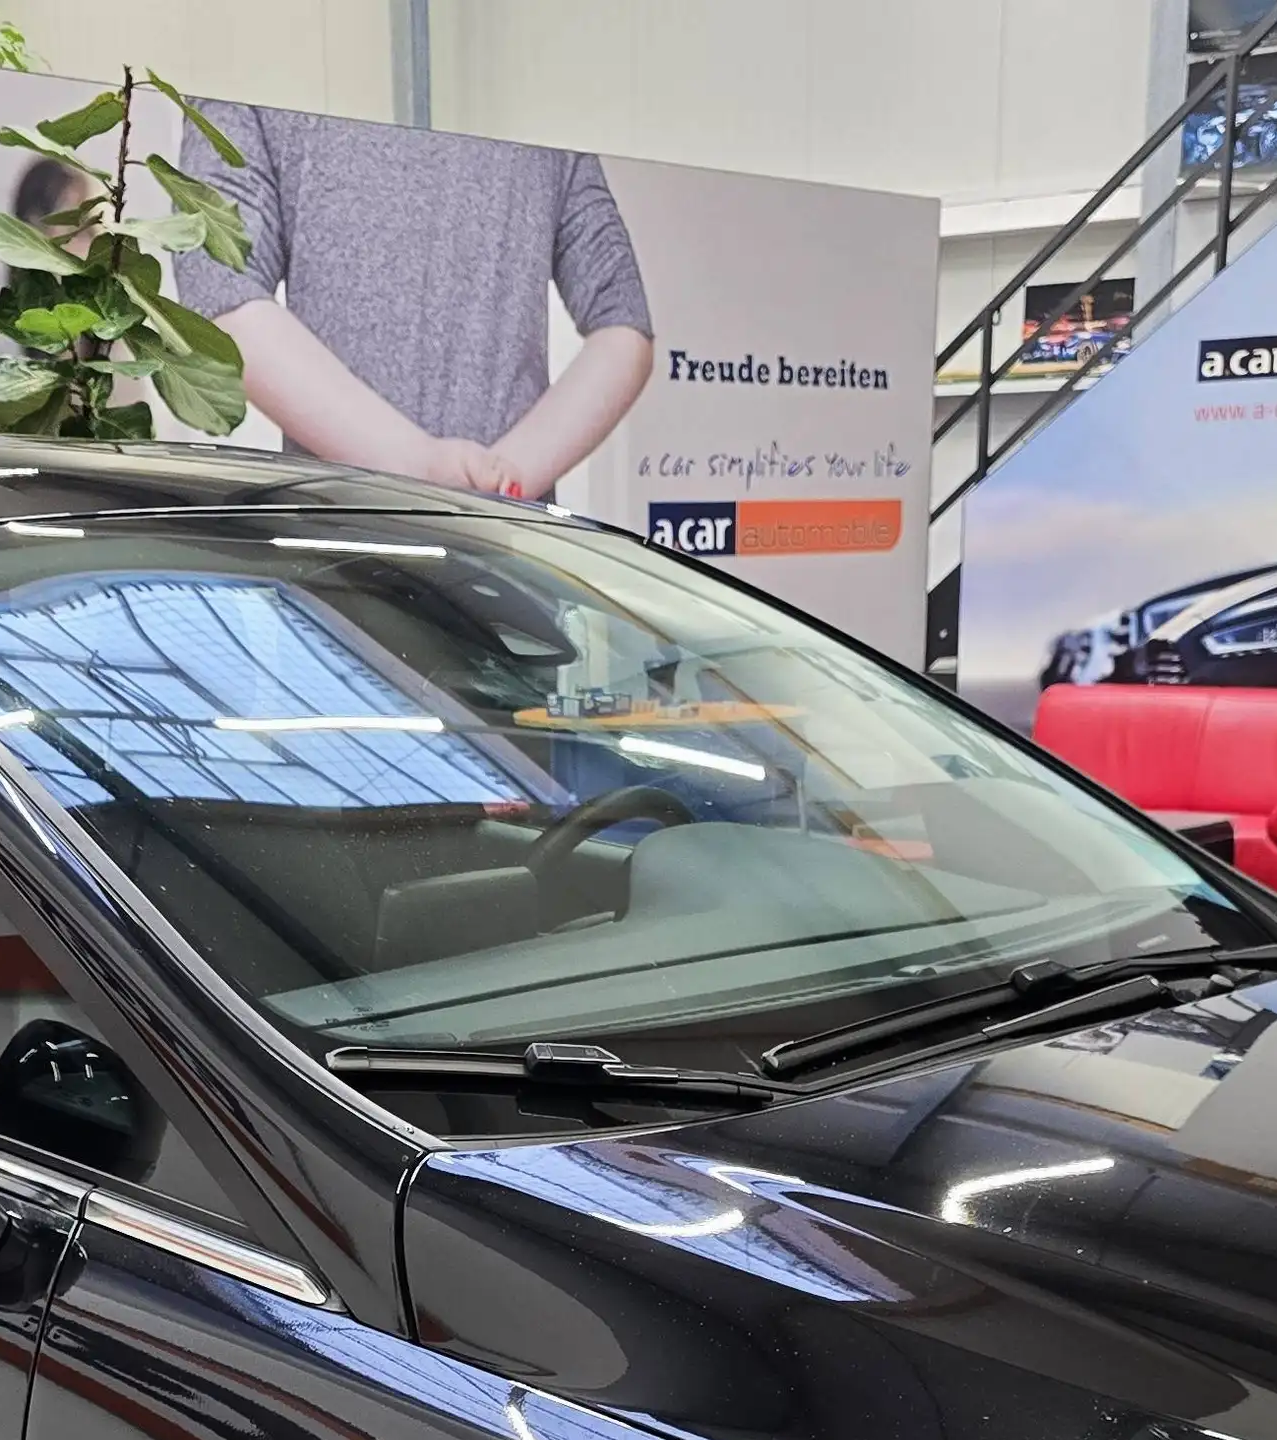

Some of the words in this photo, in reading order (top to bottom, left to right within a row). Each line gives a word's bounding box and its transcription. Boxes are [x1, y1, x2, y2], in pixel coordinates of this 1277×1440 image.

[669, 350, 770, 384] Freude
[778, 356, 889, 390] bereiten
[742, 521, 893, 549] automobile
